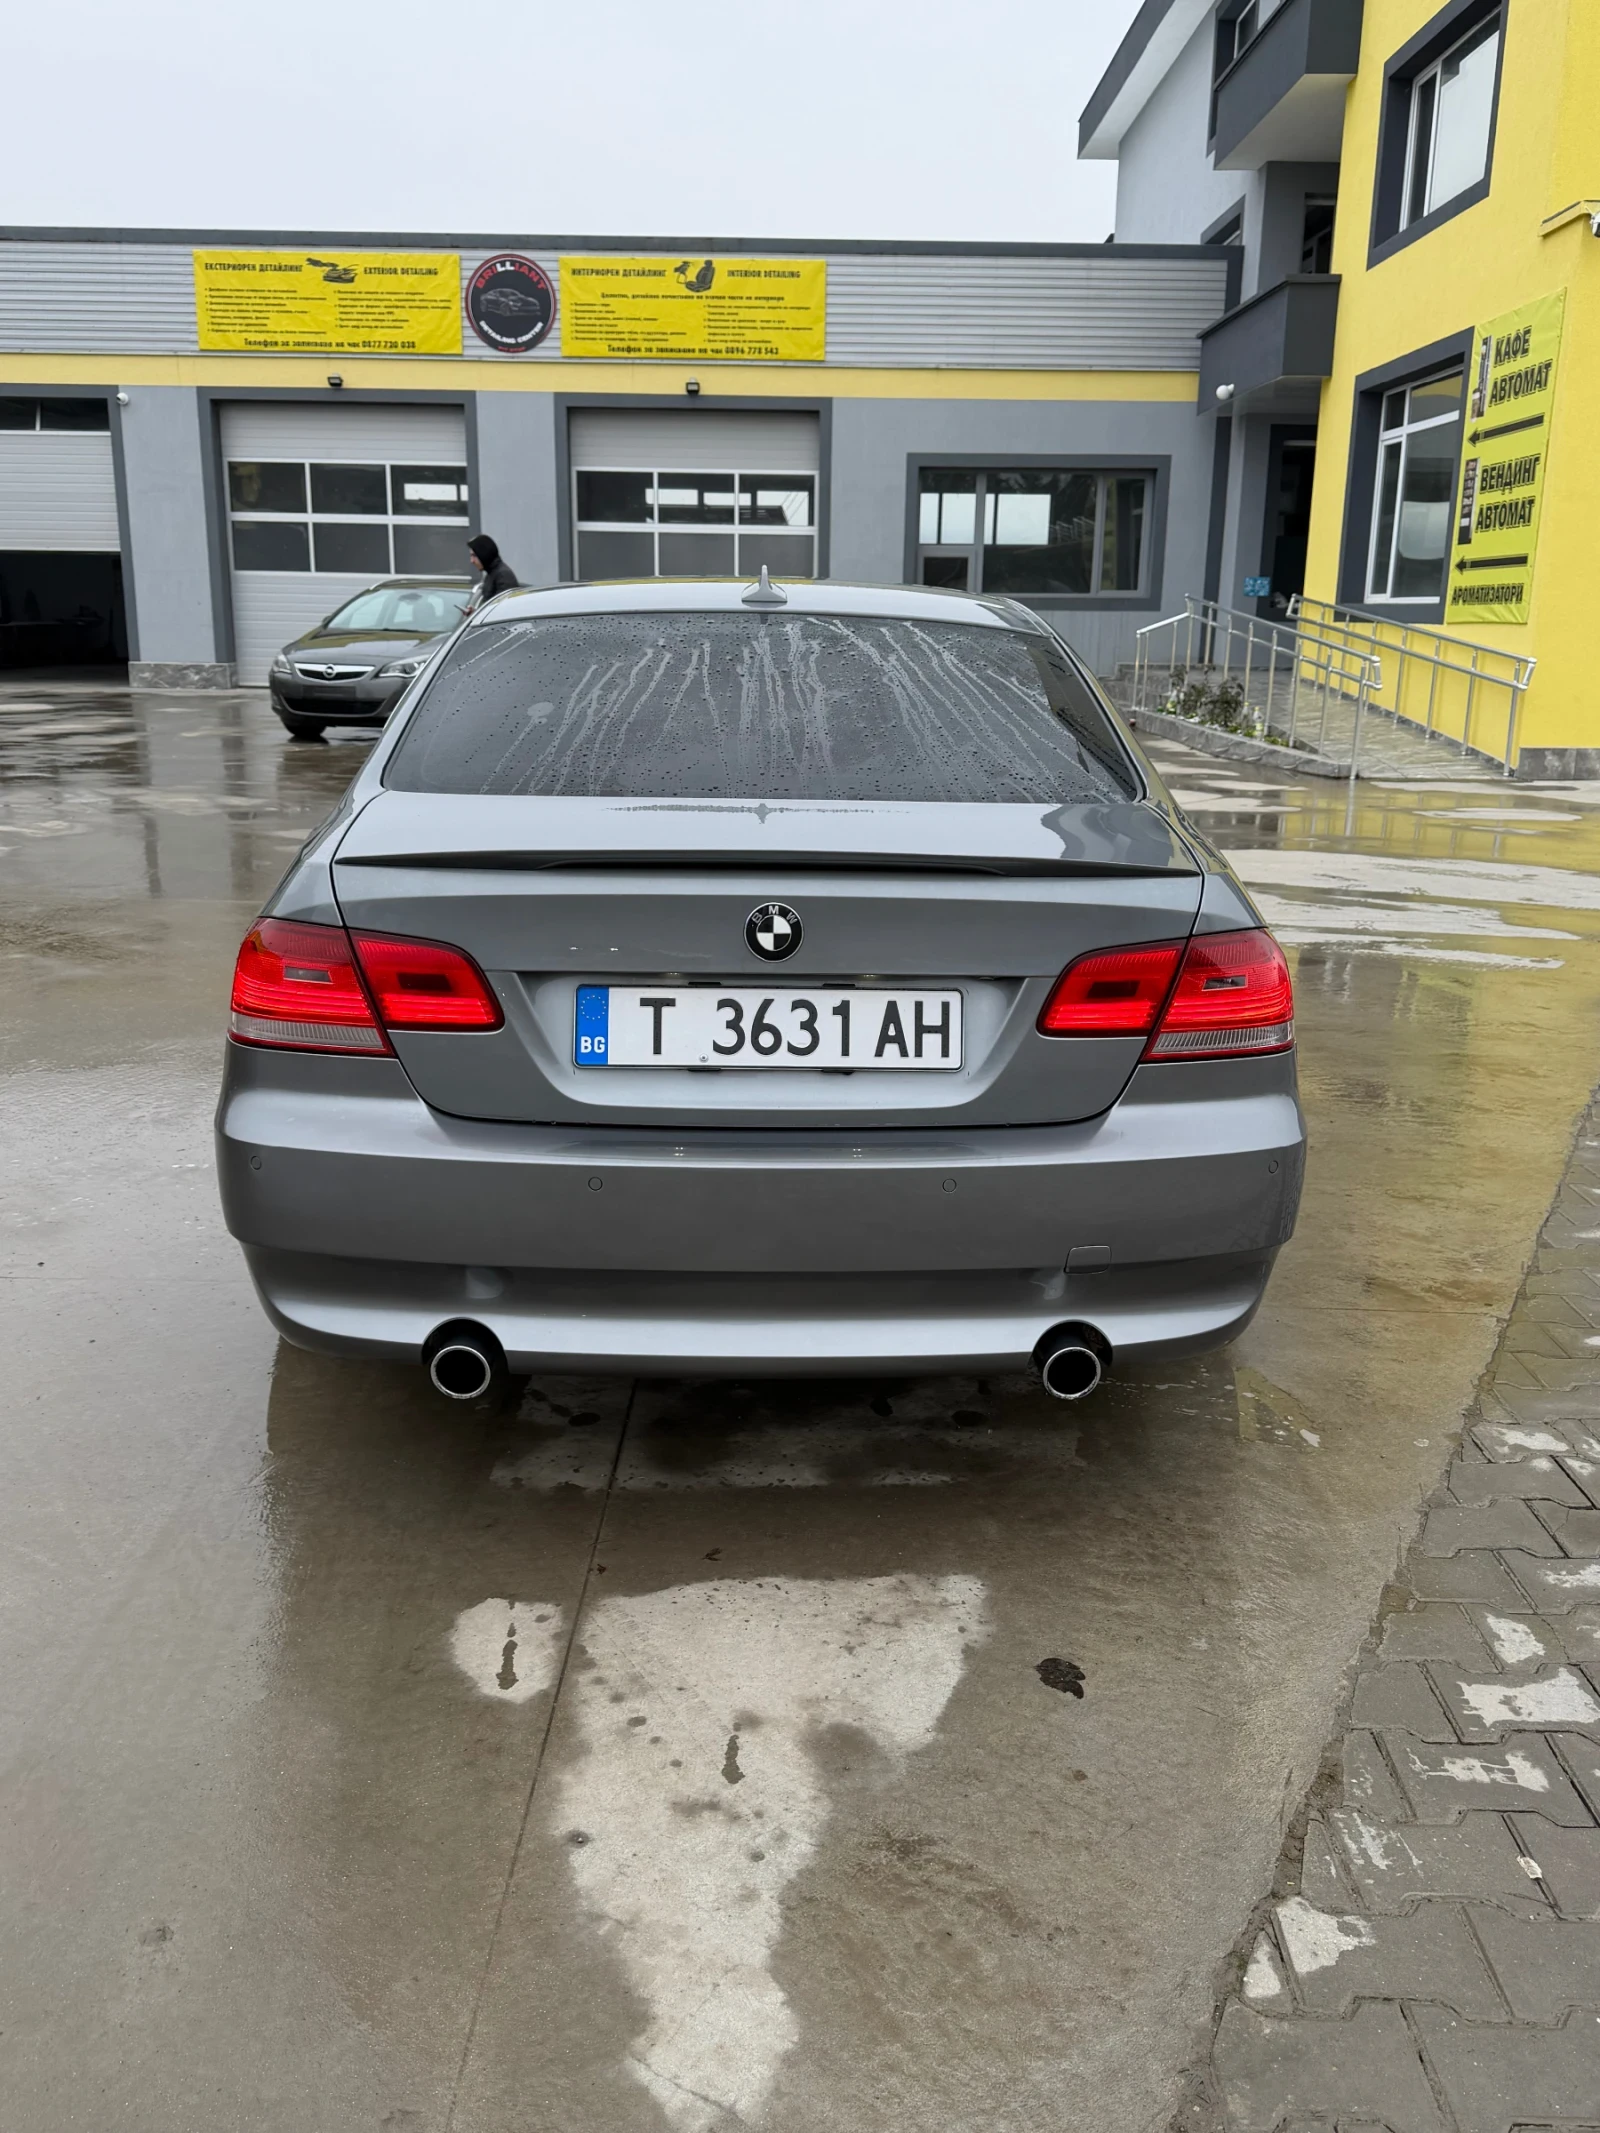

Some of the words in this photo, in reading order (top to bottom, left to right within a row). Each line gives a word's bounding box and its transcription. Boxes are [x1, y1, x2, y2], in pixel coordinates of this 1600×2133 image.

[204, 262, 257, 272] ЕКСТЕРИОРЕН
[258, 262, 303, 273] ДЕТАЙЛИНГ
[363, 266, 398, 275] EXTERIOR
[400, 267, 439, 276] DETAILING
[475, 261, 547, 290] BRILLIANT
[571, 268, 620, 277] ИНТЕРИОРЕН
[621, 267, 667, 278] ДЕТАЙЛИНГ
[727, 269, 762, 278] INTERIOR
[763, 270, 801, 279] DETAILING
[243, 337, 279, 348] Телефон
[291, 340, 333, 348] записване
[479, 320, 517, 344] DETAILING
[517, 321, 545, 344] CENTER
[607, 344, 642, 354] Телефон
[655, 346, 696, 354] записване
[1493, 325, 1532, 368] КАФЕ
[1488, 359, 1553, 407] АВТОМАТ
[1479, 453, 1541, 495] ВЕНДИНГ
[1475, 496, 1535, 533] АВТОМАТ
[1451, 583, 1524, 606] АРОМАТИЗАТОРИ
[751, 905, 798, 925] BMW
[639, 997, 676, 1055] T
[712, 998, 851, 1057] 3631
[875, 1000, 950, 1058] AH
[580, 1036, 606, 1054] BG
